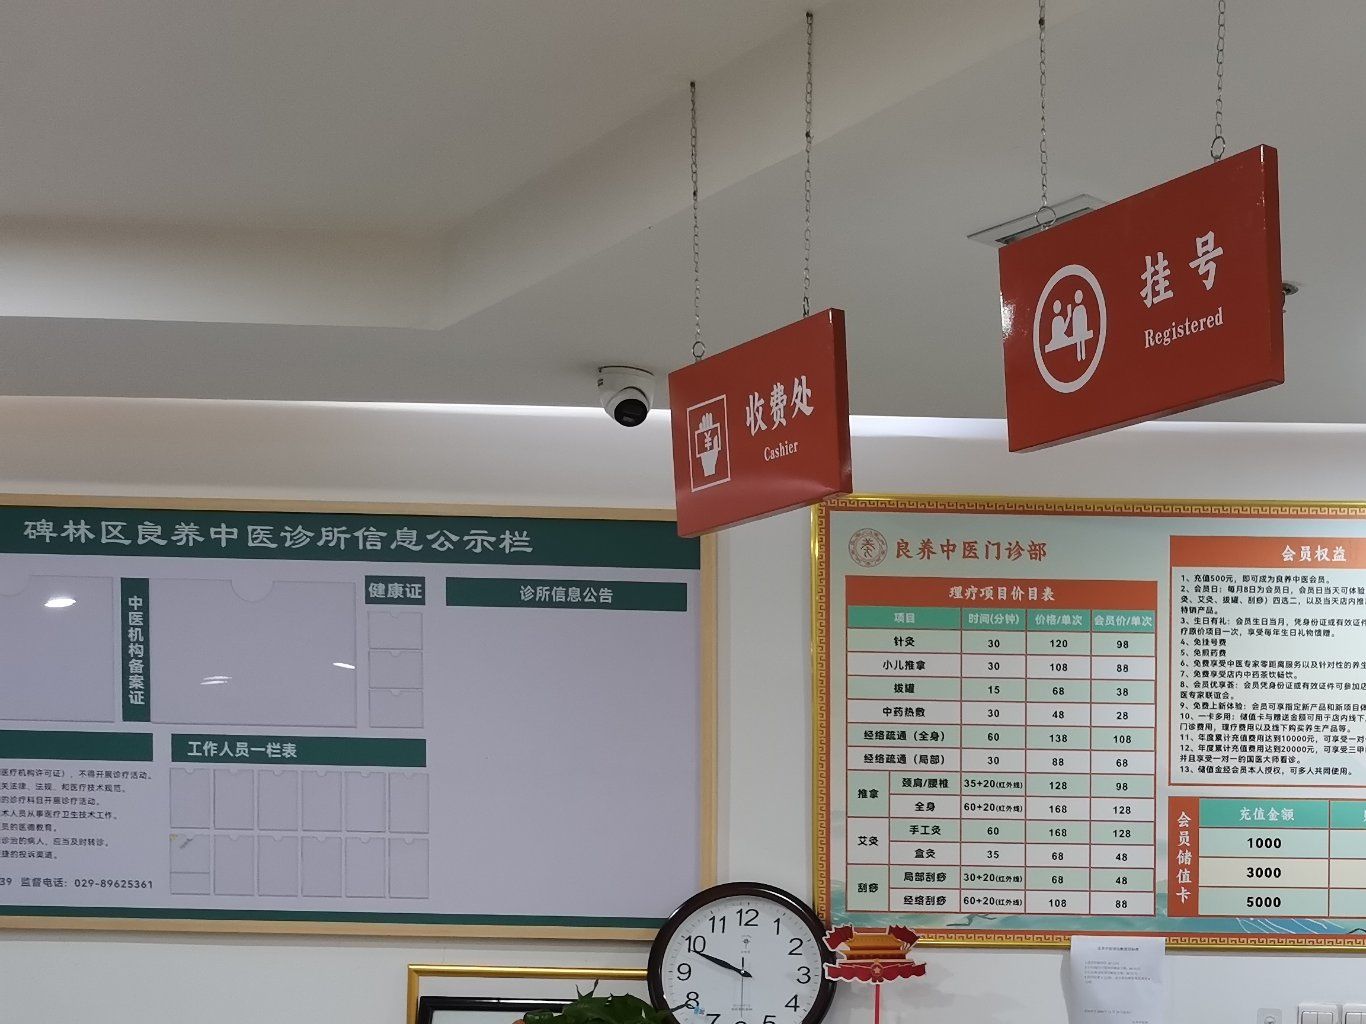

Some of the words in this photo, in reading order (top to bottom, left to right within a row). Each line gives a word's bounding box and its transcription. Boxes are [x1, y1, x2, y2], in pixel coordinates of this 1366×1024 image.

[1139, 231, 1224, 309] 挂号
[1143, 310, 1225, 348] Registered
[744, 375, 815, 437] 收费处
[763, 440, 799, 462] Cashier
[21, 519, 533, 555] 碑林区良养中医诊所信息公示栏
[895, 539, 1047, 561] 良养中医门诊部
[1282, 545, 1347, 562] 会员权益
[368, 583, 422, 598] 健康证
[520, 585, 613, 603] 诊所信息公告
[949, 585, 1055, 601] 理疗项目价目表
[894, 613, 914, 623] 项目
[969, 613, 1019, 624] 时间(分钟)
[1035, 614, 1082, 625] 价格/单次
[1095, 615, 1152, 626] 会员价/单次
[894, 636, 915, 646] 针灸
[128, 596, 145, 704] 中医机构备案证
[883, 660, 925, 670] 小儿推拿
[988, 662, 999, 670] 30
[1050, 663, 1067, 671] 108
[1117, 664, 1128, 672] 88
[894, 683, 914, 693] 拔罐
[988, 686, 1000, 694] 15
[1053, 687, 1064, 695] 68
[1117, 688, 1128, 696] 38
[883, 707, 925, 717] 中药热敷
[988, 709, 999, 717] 30
[1052, 711, 1064, 719] 48
[1117, 712, 1128, 720] 28
[864, 730, 944, 741] 经络疏通（全身）
[988, 733, 999, 741] 60
[1050, 734, 1067, 742] 138
[1114, 735, 1131, 743] 108
[188, 741, 297, 758] 工作人员一栏表
[864, 754, 944, 765] 经络疏通（局部）
[1052, 758, 1064, 766] 88
[1116, 759, 1128, 767] 68
[858, 789, 879, 798] 推拿
[1116, 783, 1128, 791] 98
[915, 802, 935, 811] 全身
[1049, 805, 1067, 813] 168
[1113, 806, 1131, 814] 128
[1240, 807, 1294, 821] 充值金额
[910, 825, 941, 835] 手工灸
[987, 827, 999, 835] 60
[1049, 829, 1066, 837] 168
[858, 836, 878, 846] 艾灸
[1248, 838, 1281, 848] 1000
[915, 849, 935, 858] 盒灸
[987, 851, 999, 859] 35
[1052, 852, 1063, 860] 68
[1116, 853, 1127, 861] 48
[1176, 812, 1192, 903] 会员储值卡
[904, 872, 946, 882] 局部刮痧
[1052, 876, 1063, 884] 68
[1247, 867, 1281, 878] 3000
[858, 883, 878, 893] 刮痧
[904, 895, 946, 905] 经络刮痧
[1049, 899, 1066, 907] 108
[1116, 900, 1127, 908] 88
[1247, 897, 1281, 907] 5000
[709, 916, 726, 933] 11
[736, 909, 759, 926] 12
[774, 918, 780, 935] 1
[685, 935, 706, 953] 10
[788, 938, 803, 955] 2
[677, 963, 691, 981] 9
[796, 966, 811, 984] 3
[685, 992, 699, 1009] 8
[785, 994, 800, 1012] 4
